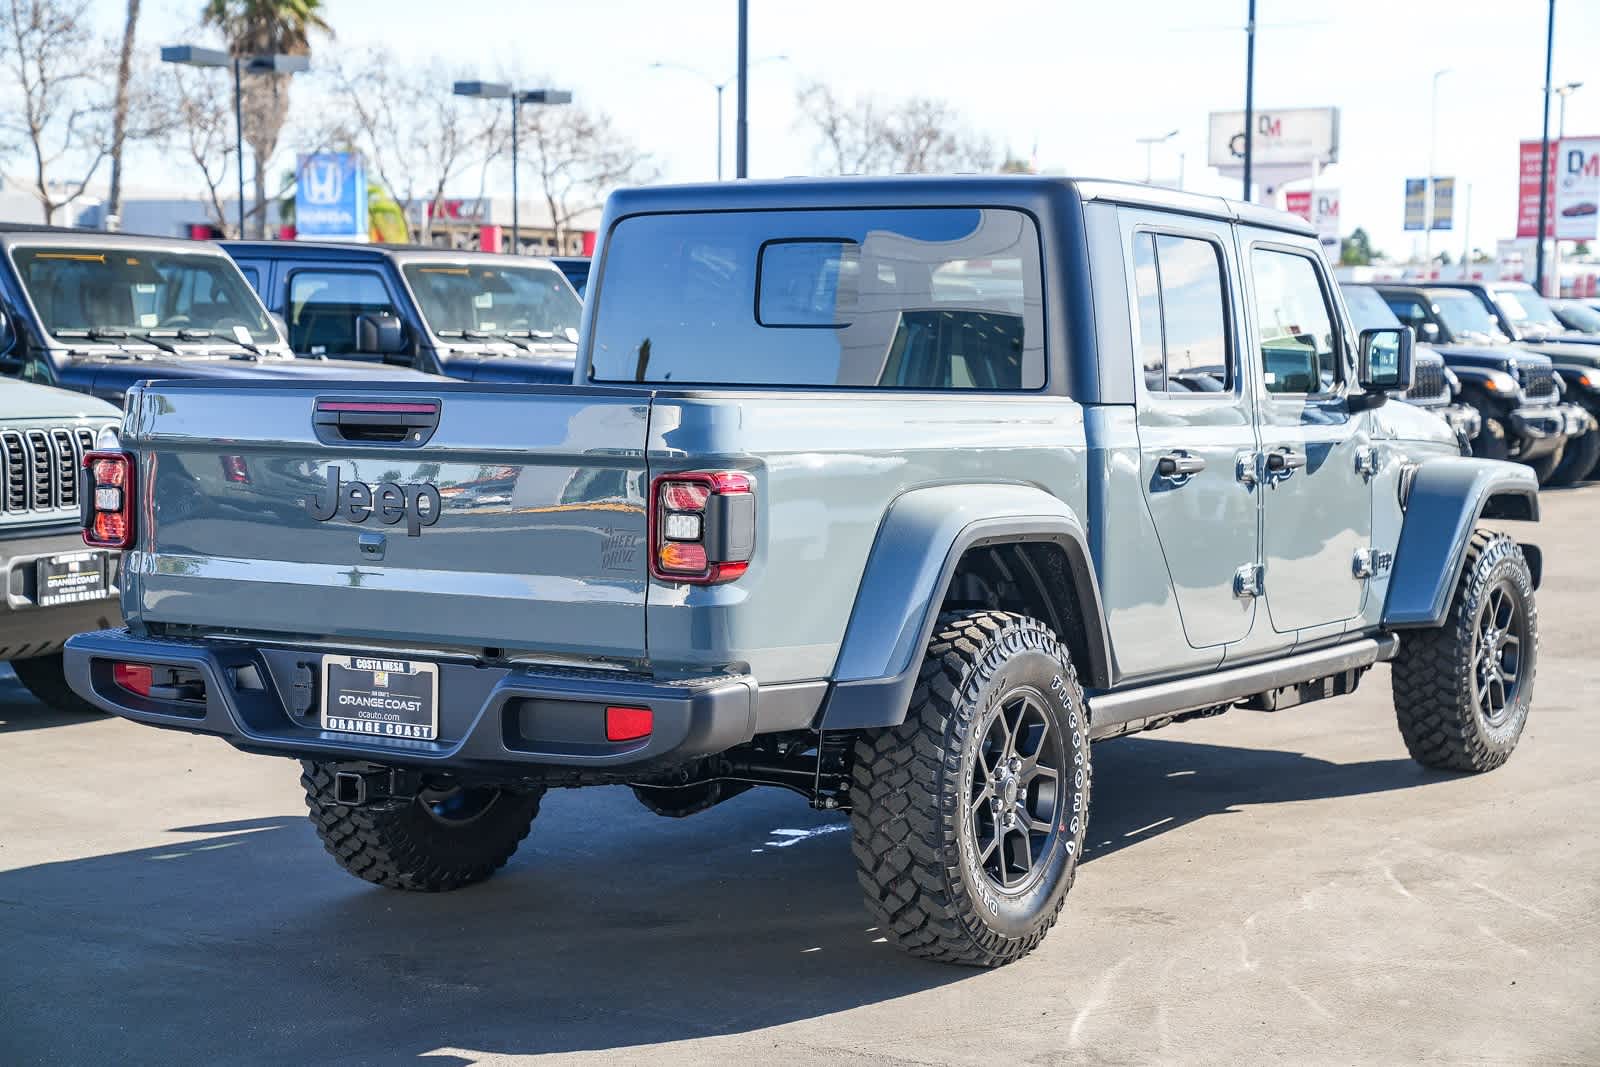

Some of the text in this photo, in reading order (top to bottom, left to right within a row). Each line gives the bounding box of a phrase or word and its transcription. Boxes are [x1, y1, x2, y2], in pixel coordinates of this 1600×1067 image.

[304, 465, 441, 537] Jeep
[356, 659, 404, 673] COSTA MESA
[358, 710, 400, 721] ocauto.com
[329, 718, 431, 738] ORANGE COAST
